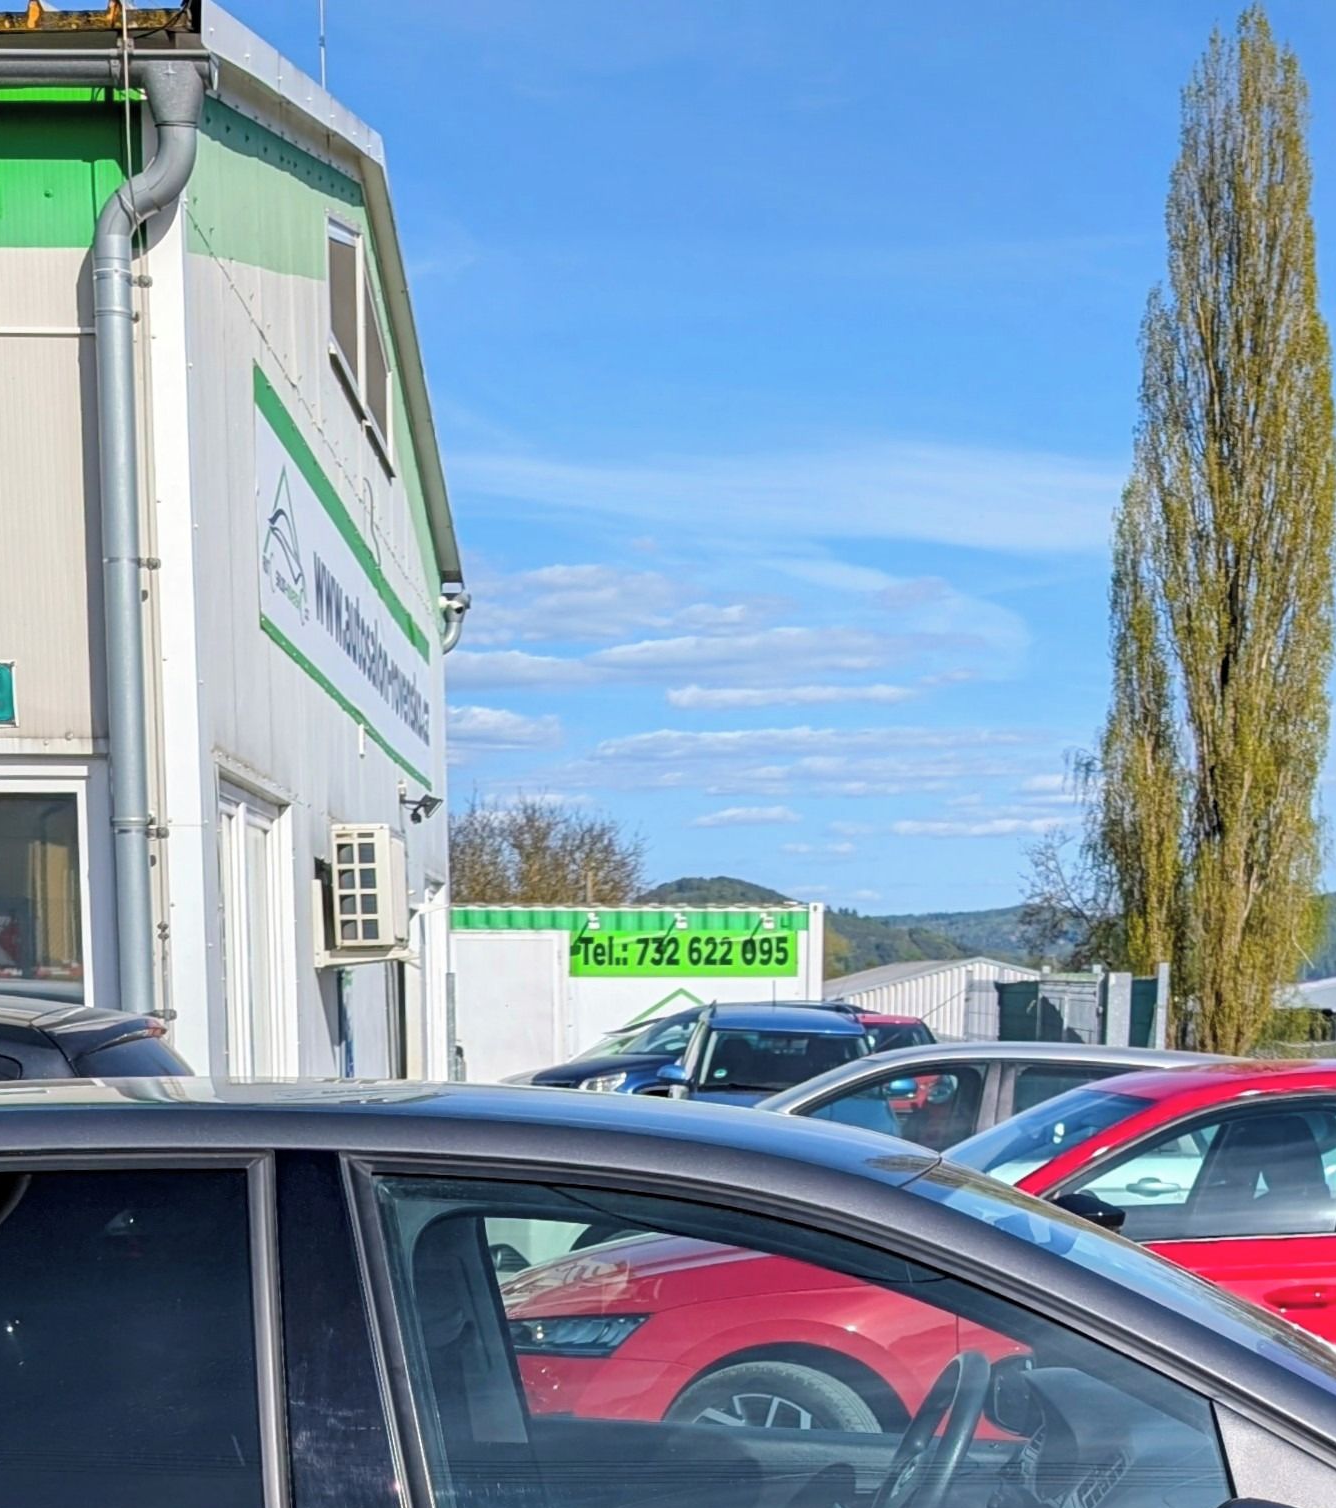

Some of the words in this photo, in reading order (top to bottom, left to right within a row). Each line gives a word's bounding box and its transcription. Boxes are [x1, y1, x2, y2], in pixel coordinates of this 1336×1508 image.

[579, 935, 628, 966] Tel.:
[636, 936, 679, 966] 732
[688, 936, 733, 966] 622
[741, 936, 789, 966] 095
